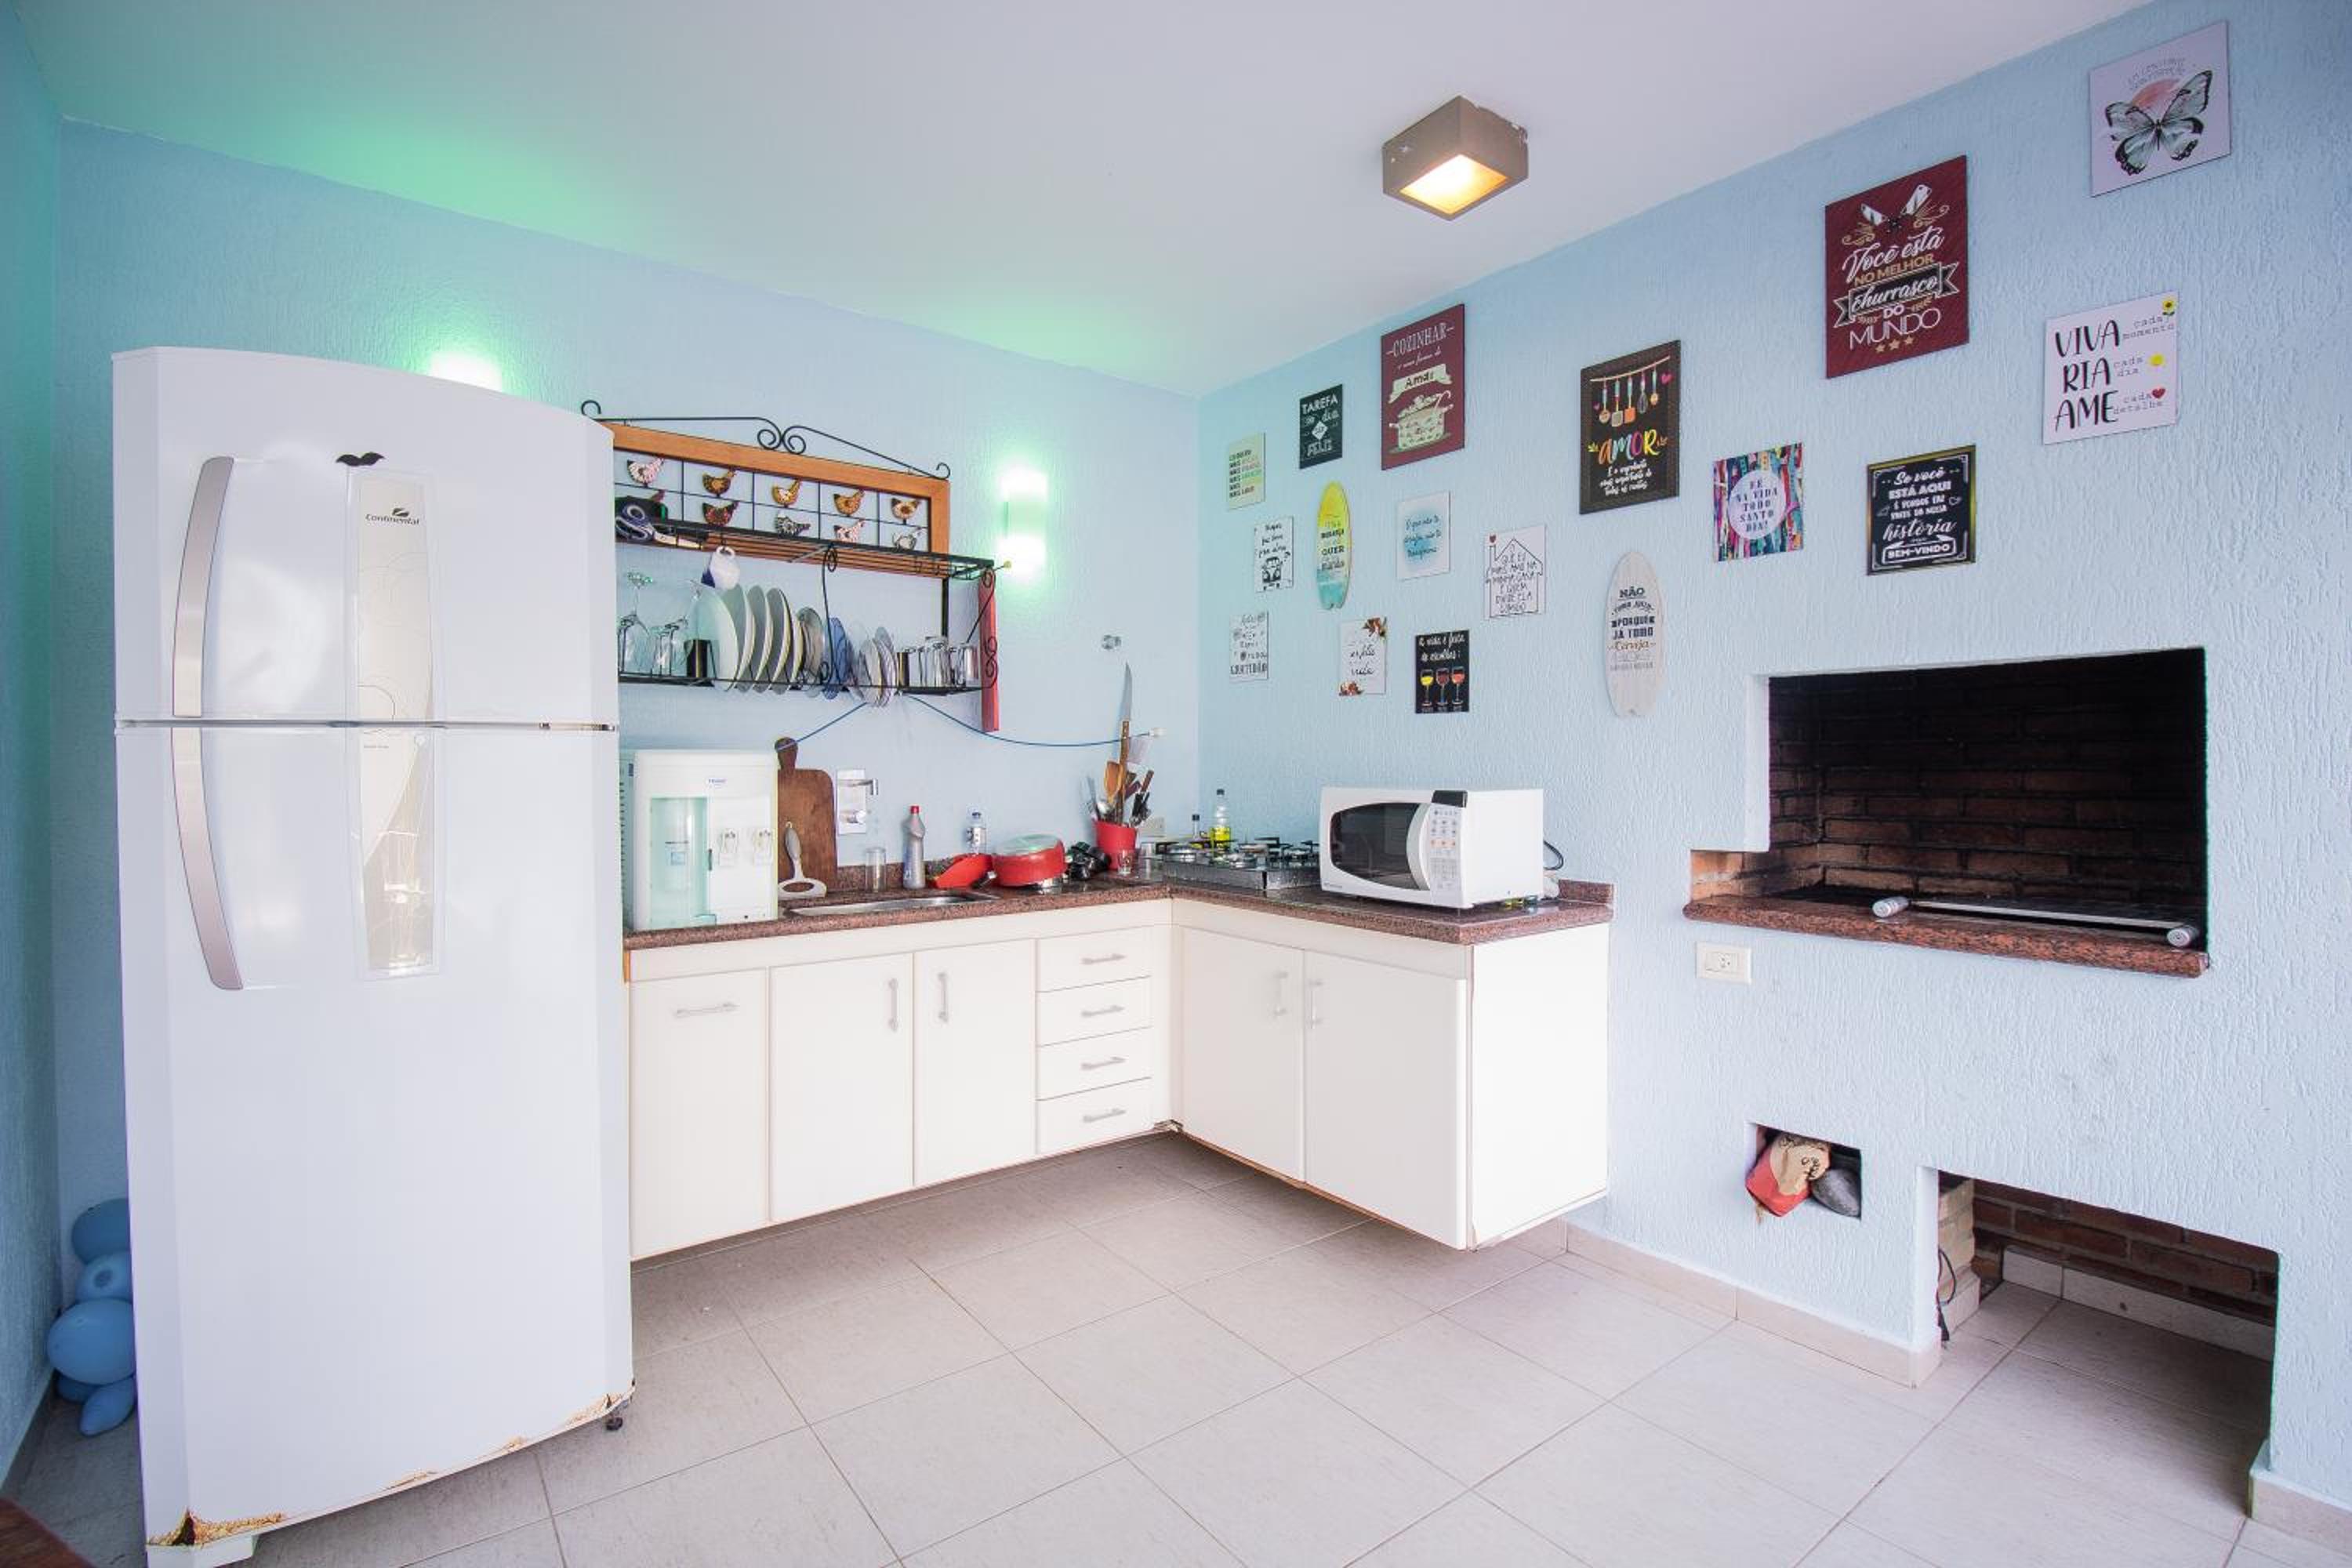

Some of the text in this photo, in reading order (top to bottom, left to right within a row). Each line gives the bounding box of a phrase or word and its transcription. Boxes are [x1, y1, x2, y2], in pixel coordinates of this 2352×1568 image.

[1842, 226, 1944, 283] Você está
[1855, 253, 1935, 287] NO MELHOR
[1851, 274, 1938, 313] churrasco
[1884, 304, 1905, 319] DO
[1849, 308, 1941, 350] MUNDO
[2133, 315, 2163, 328] cada
[2055, 319, 2120, 358] VIVA
[2122, 323, 2175, 339] momento
[1392, 322, 1447, 358] COZINHAR
[2114, 357, 2143, 369] cada
[2063, 358, 2110, 394] RIA
[1301, 394, 1338, 415] TAREFA
[2123, 391, 2153, 404] cada
[2054, 390, 2118, 432] AME
[1753, 487, 1777, 499] VIDA
[1889, 481, 1952, 500] ESTÁ AQUI
[1743, 499, 1771, 512] TODO
[365, 514, 420, 525] Continental
[1739, 510, 1774, 523] SANTO
[1321, 545, 1345, 556] QUER
[1887, 543, 1951, 559] BEM-VINDO
[1619, 586, 1646, 598] NÃO
